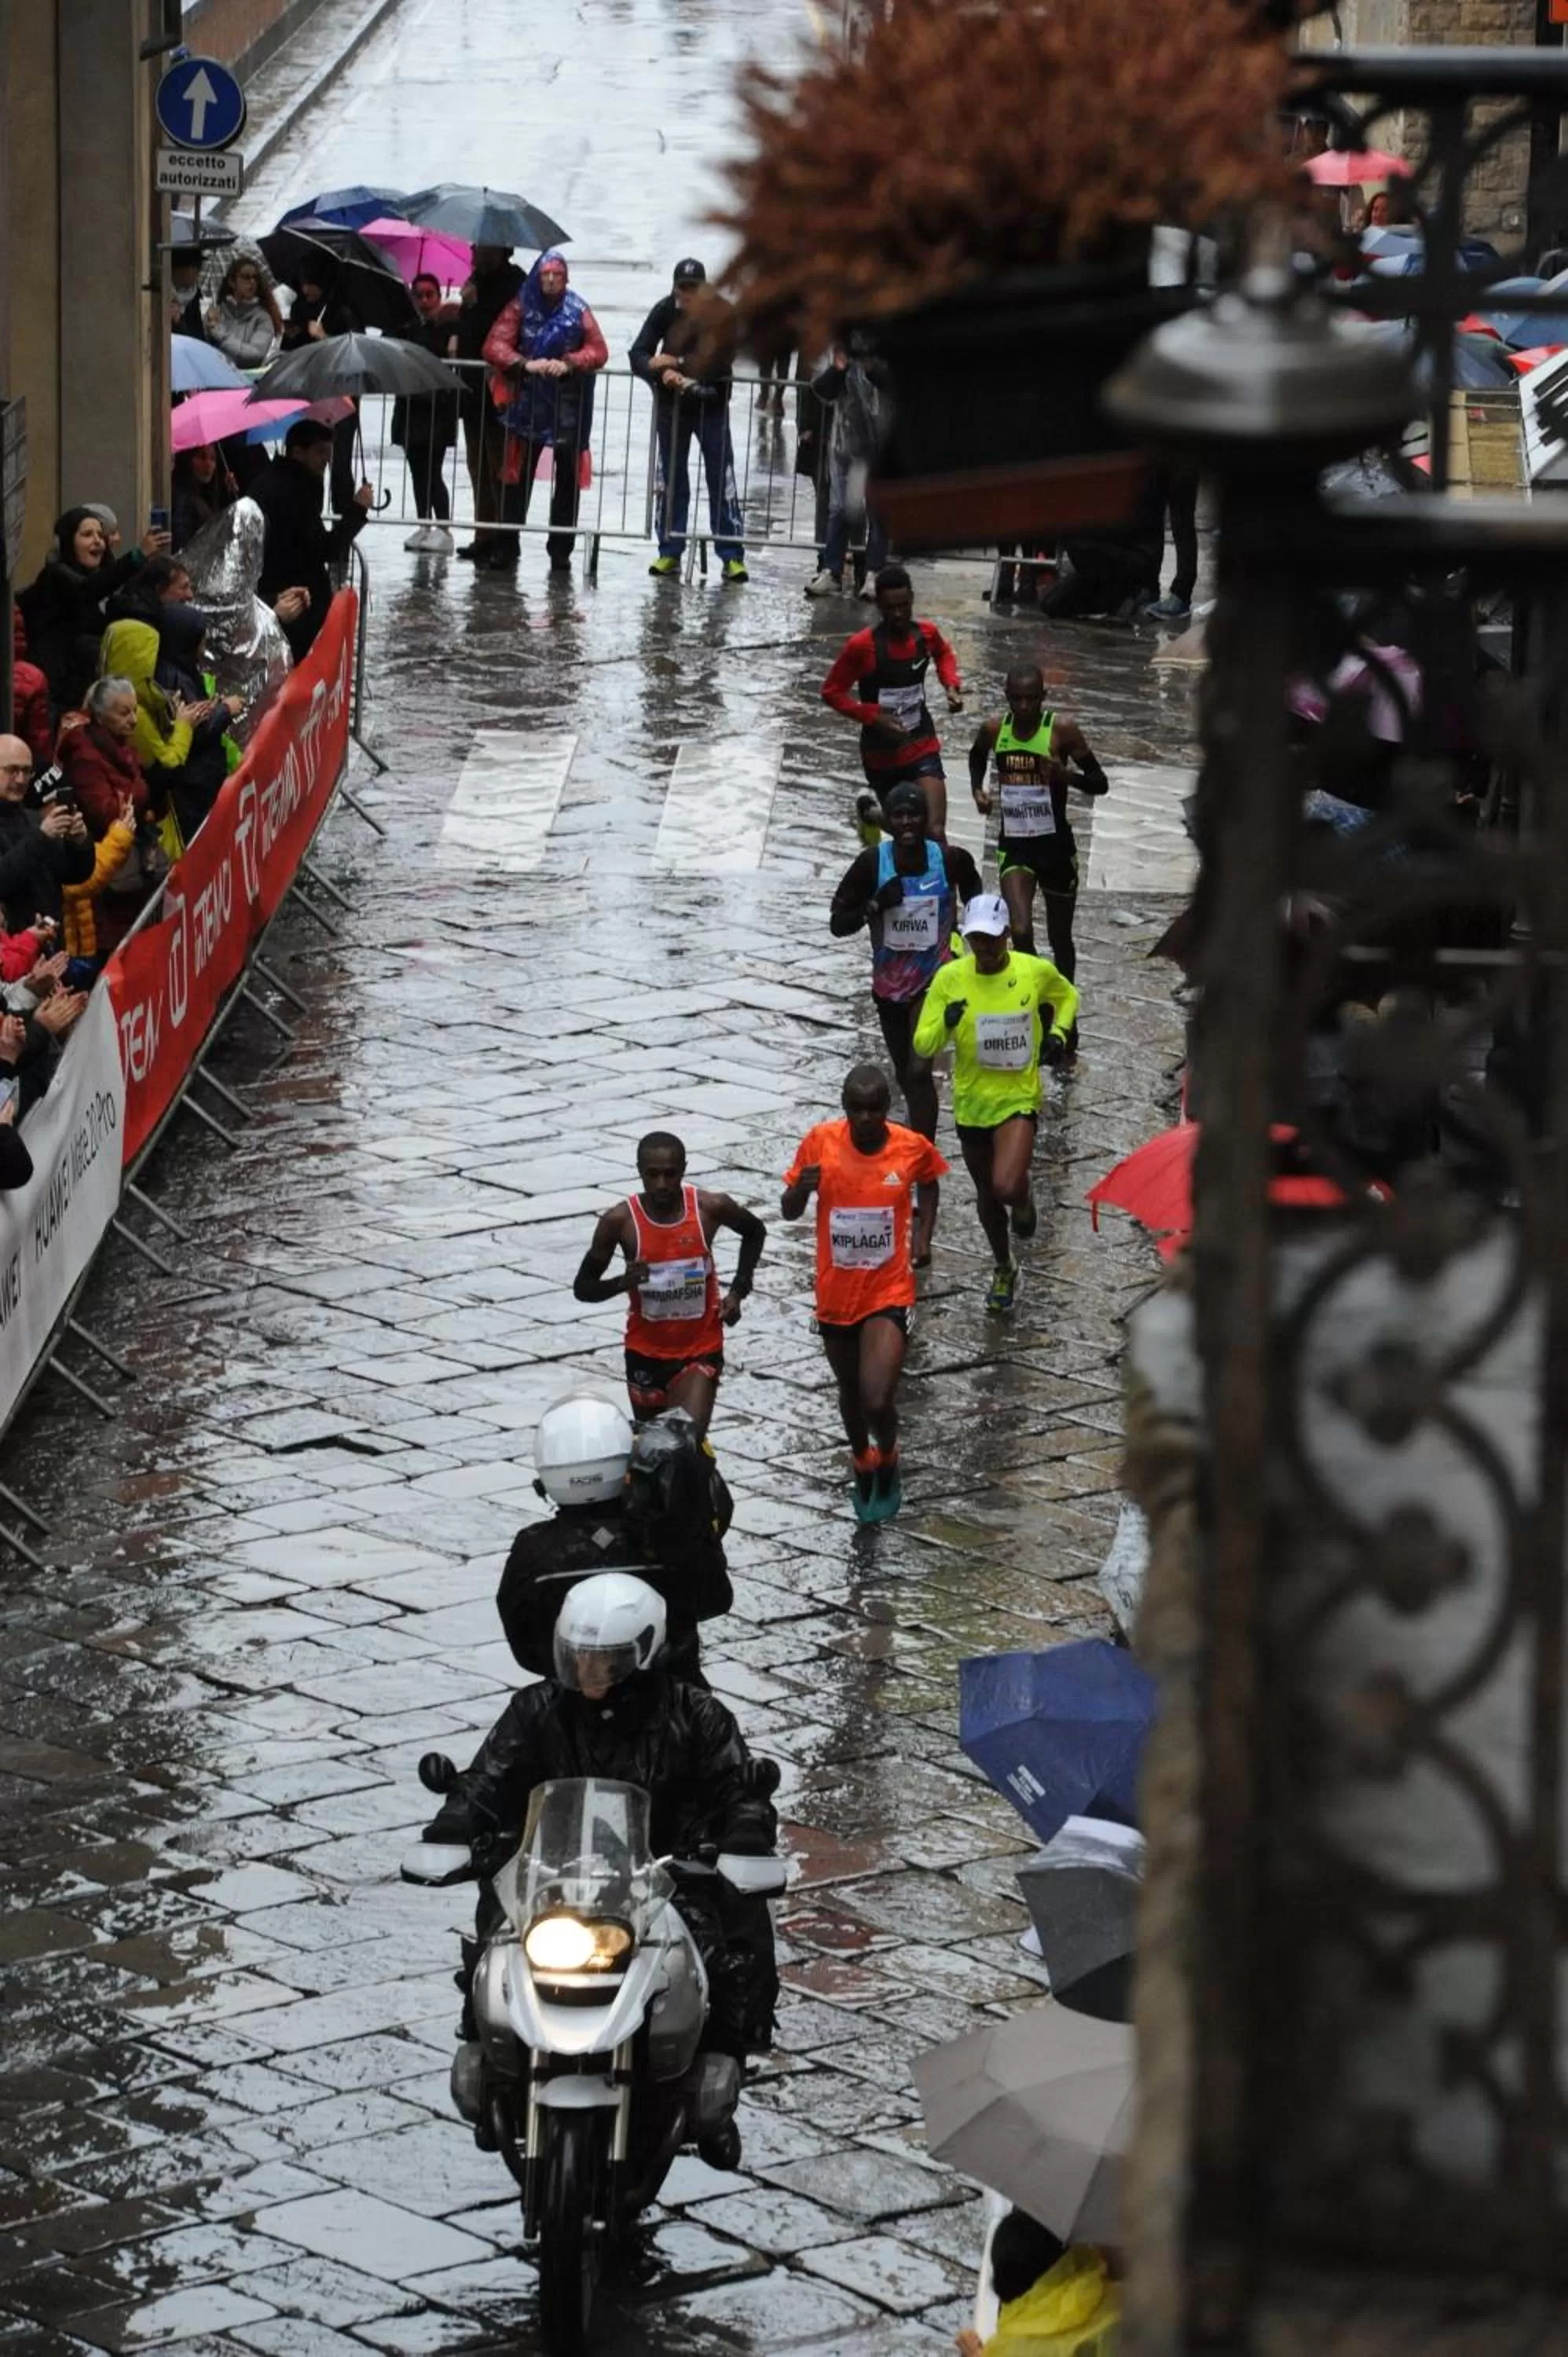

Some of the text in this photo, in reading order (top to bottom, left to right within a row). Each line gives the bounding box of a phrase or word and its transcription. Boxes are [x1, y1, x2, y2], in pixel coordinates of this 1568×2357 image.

[169, 155, 225, 169] eccetto
[159, 172, 236, 189] autorizzati
[892, 917, 929, 933] KIRWA
[983, 1034, 1028, 1051] DIREBA
[35, 1152, 71, 1264] HUAWEI
[94, 1089, 116, 1151] Pro
[831, 1231, 892, 1249] KIPLAGAT
